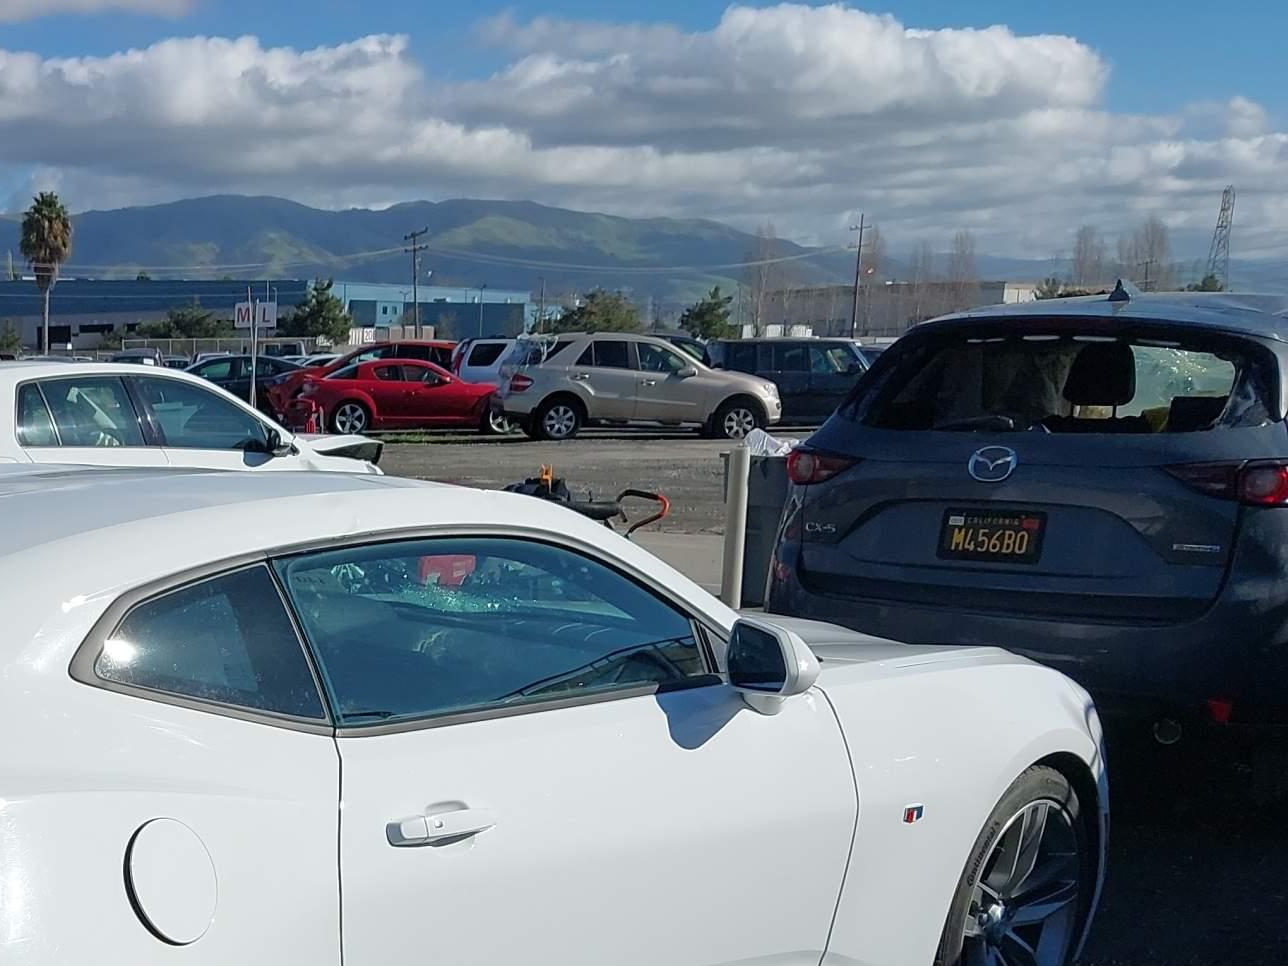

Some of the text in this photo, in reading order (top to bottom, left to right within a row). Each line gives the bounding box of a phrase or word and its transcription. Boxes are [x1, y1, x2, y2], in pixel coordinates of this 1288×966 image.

[237, 307, 271, 323] M L
[805, 521, 836, 533] CX-5
[967, 516, 1019, 526] CALIFORNIA
